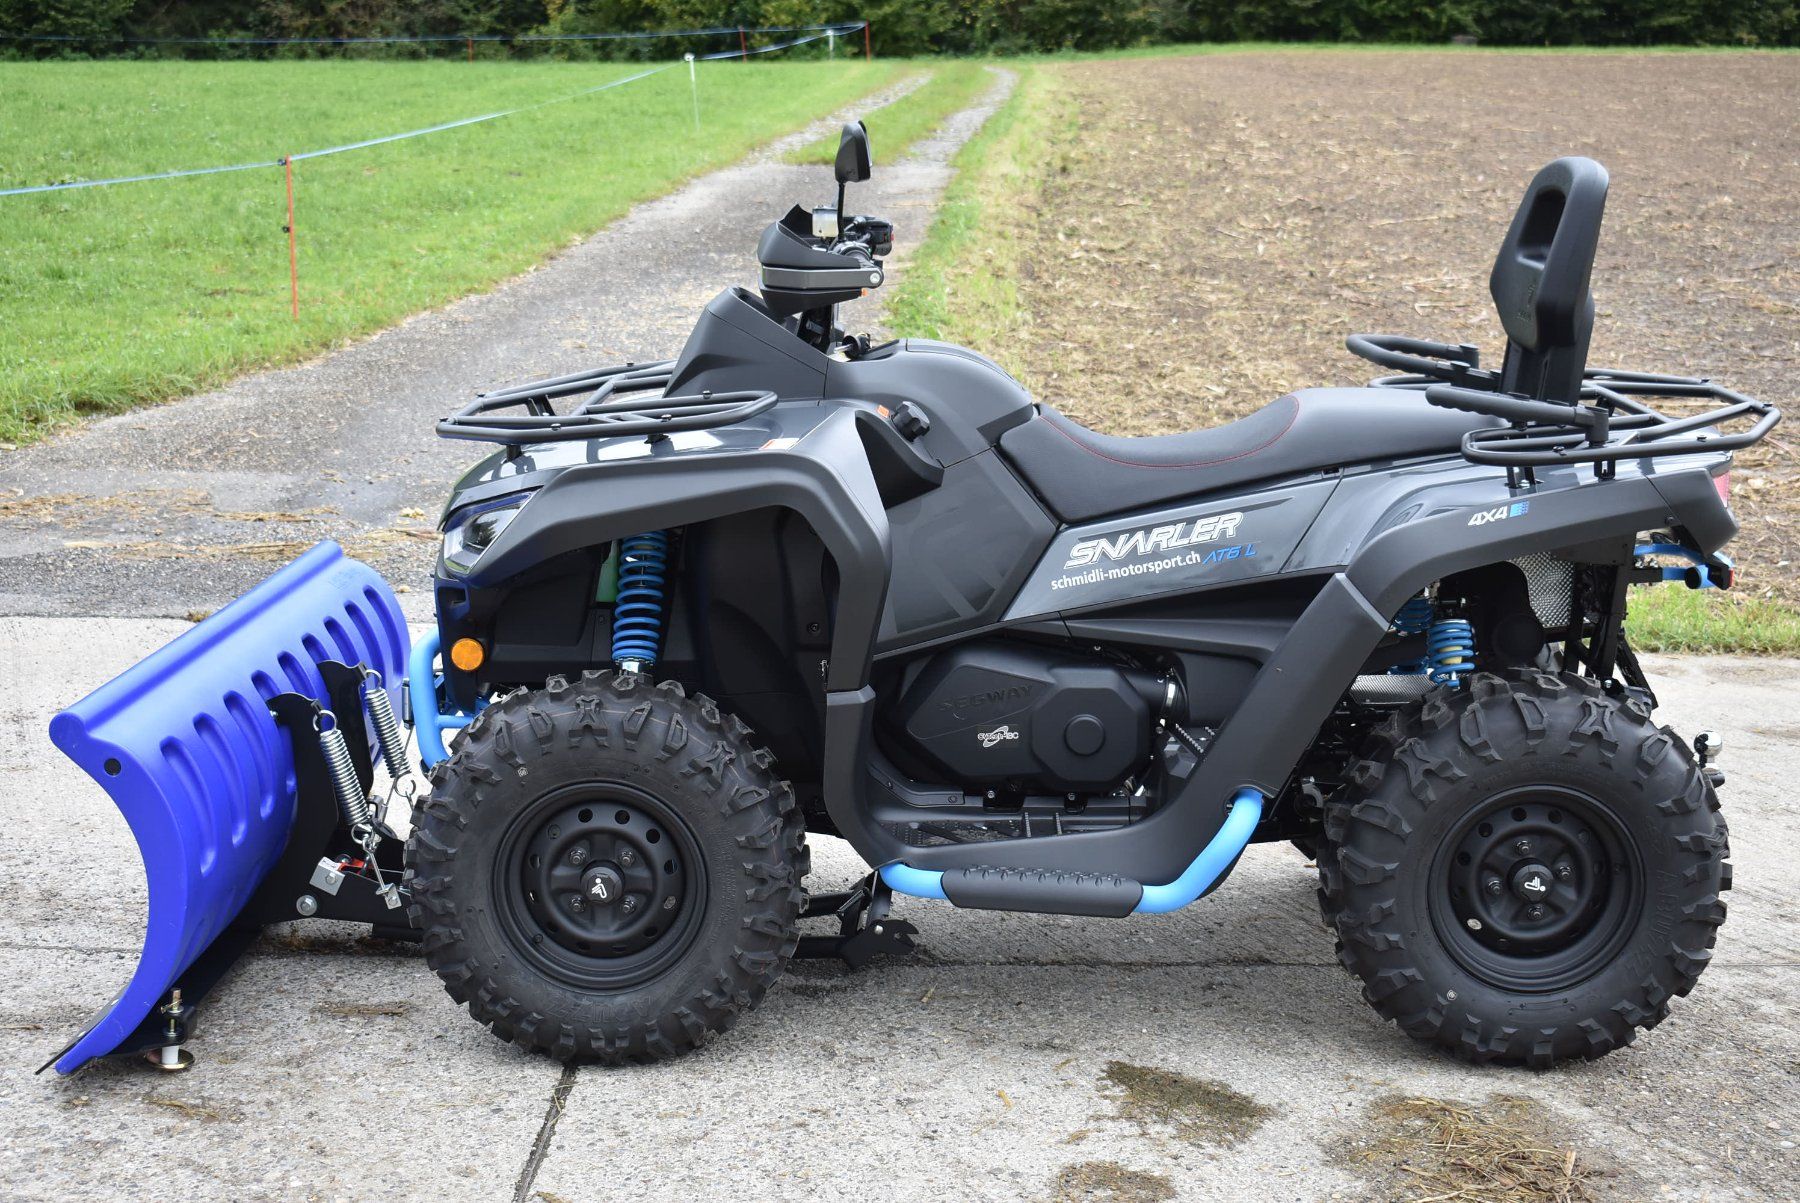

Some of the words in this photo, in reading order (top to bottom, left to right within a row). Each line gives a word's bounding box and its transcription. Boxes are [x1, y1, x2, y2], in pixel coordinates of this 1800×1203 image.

[1063, 511, 1244, 570] SNARLER
[1244, 543, 1257, 557] L
[1051, 550, 1201, 591] schmidli-motorsport.ch
